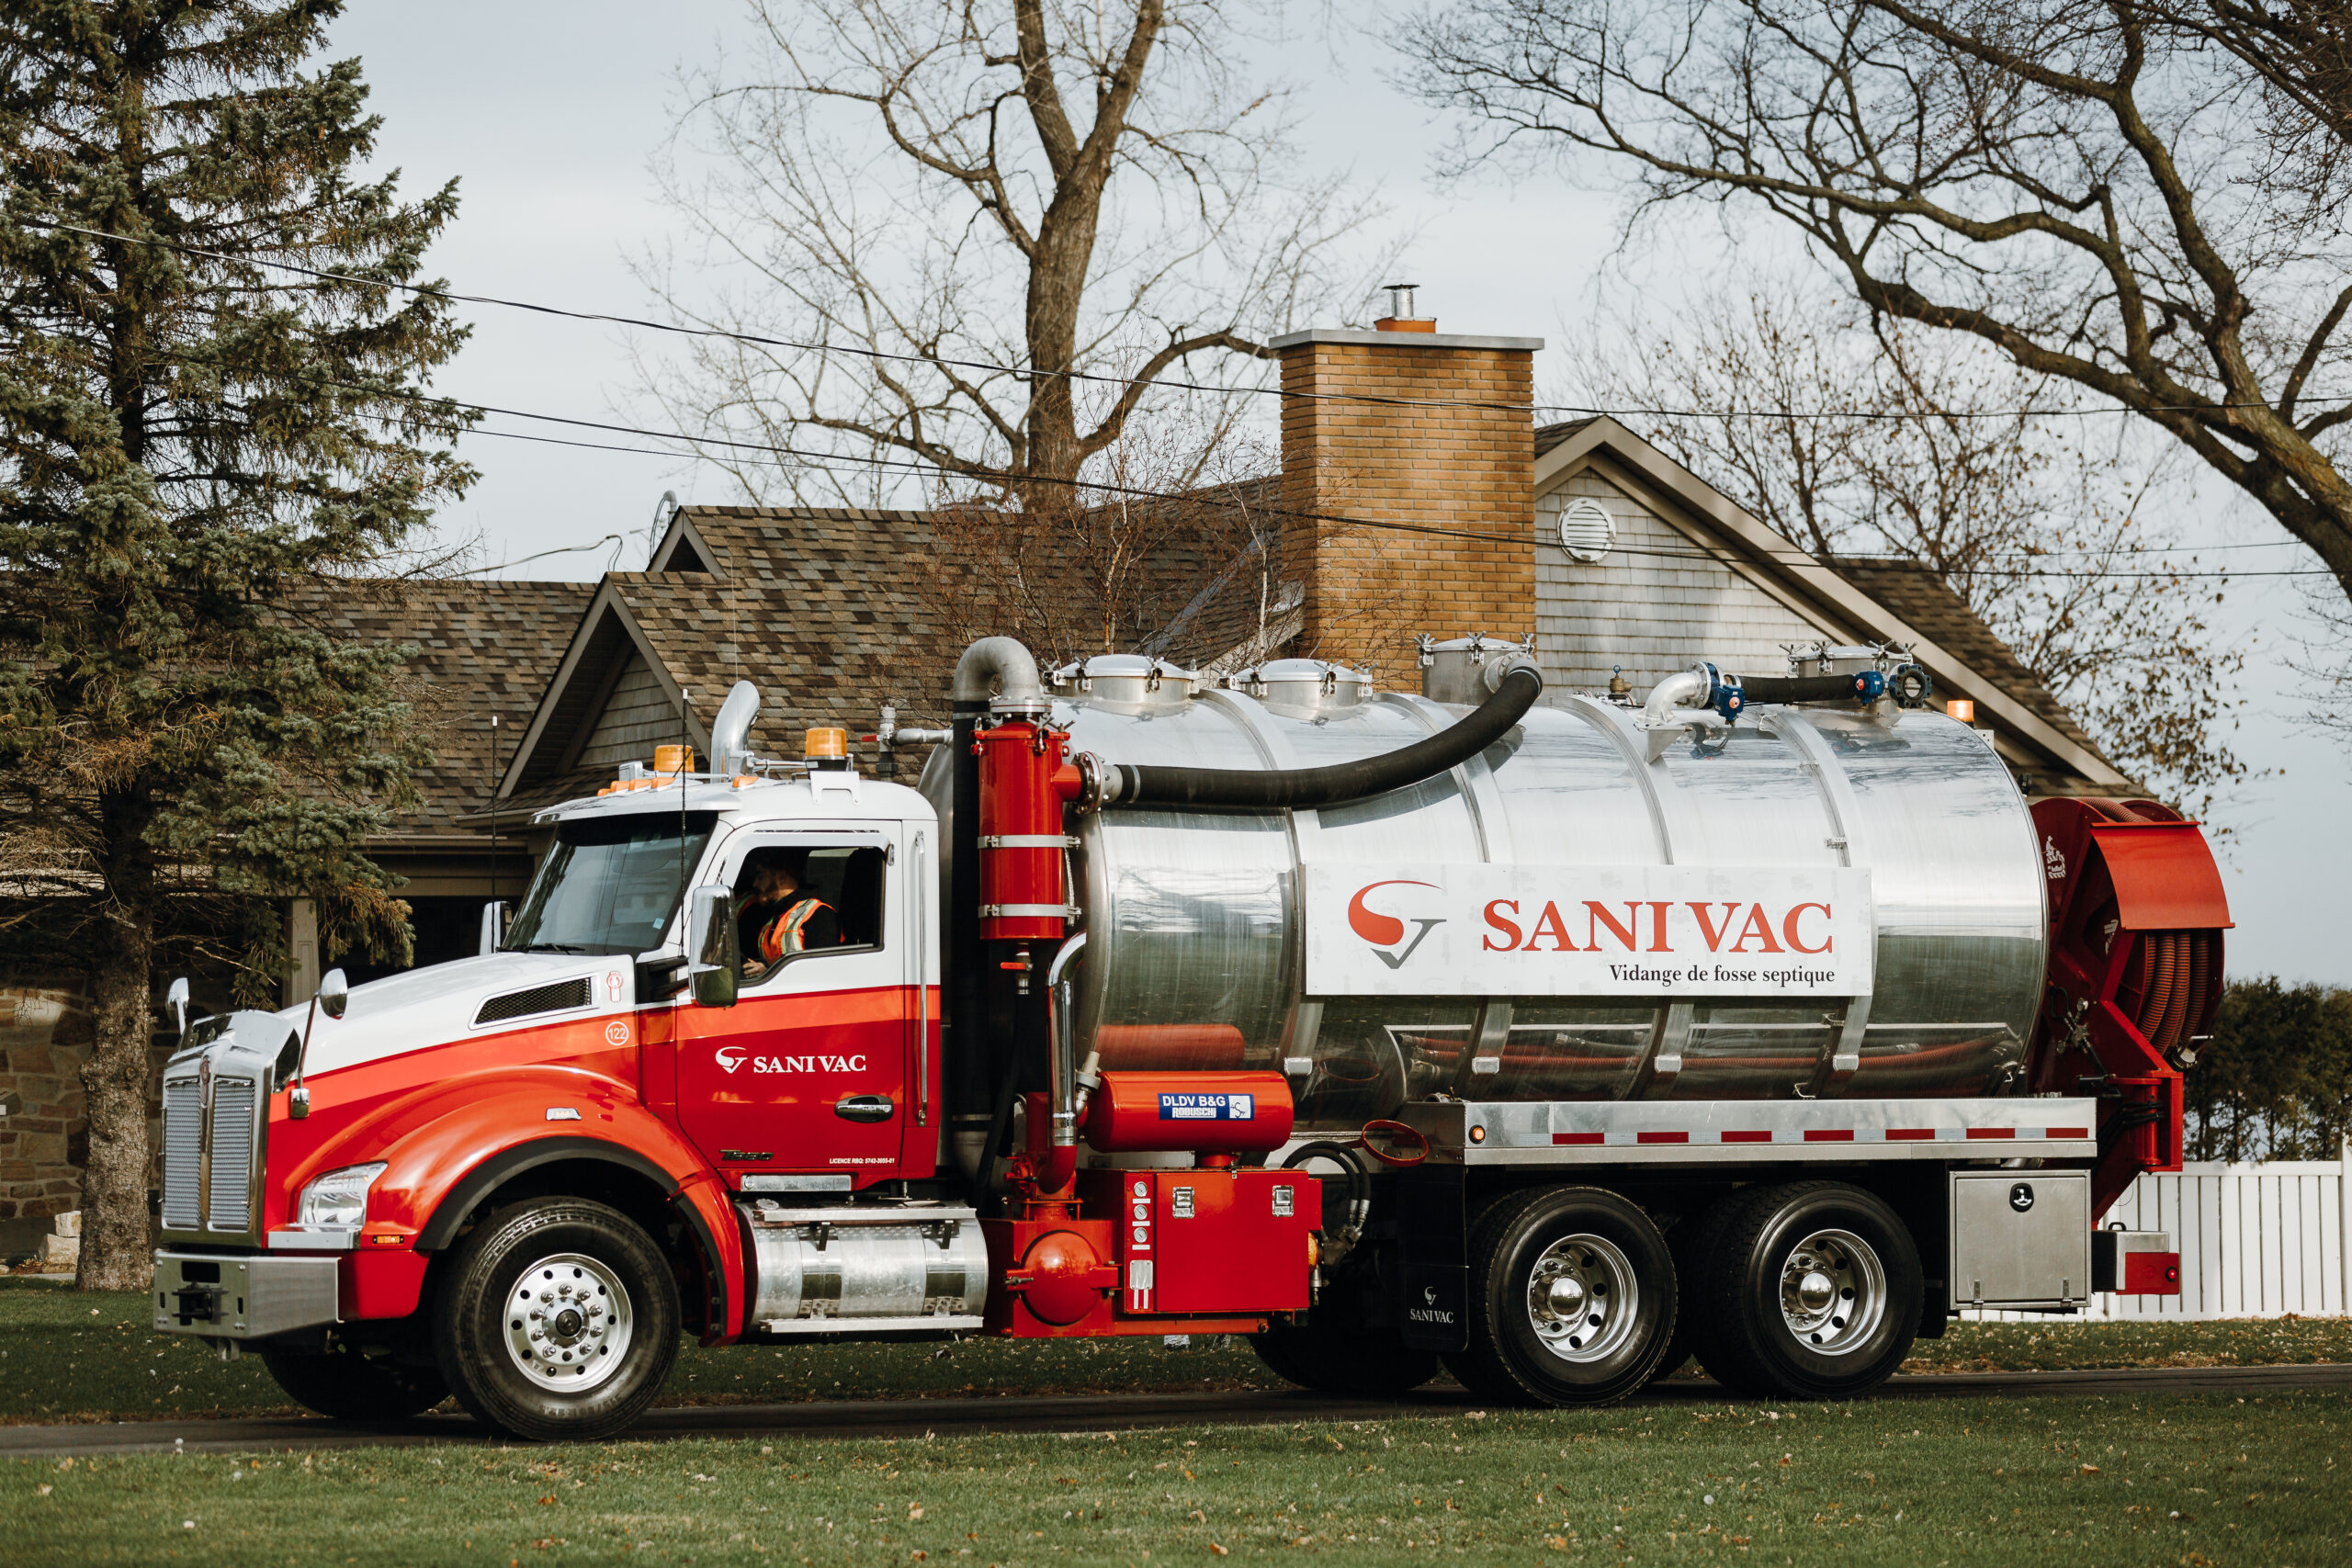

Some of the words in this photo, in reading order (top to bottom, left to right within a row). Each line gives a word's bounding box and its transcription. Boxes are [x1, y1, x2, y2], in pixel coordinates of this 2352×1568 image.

[1609, 964, 1682, 987] Vidange
[1687, 964, 1709, 982] de
[1713, 964, 1757, 982] fosse
[1762, 964, 1836, 988] septique
[609, 1028, 627, 1040] 122
[1162, 1095, 1195, 1107] DLDV
[1198, 1095, 1227, 1107] B&G
